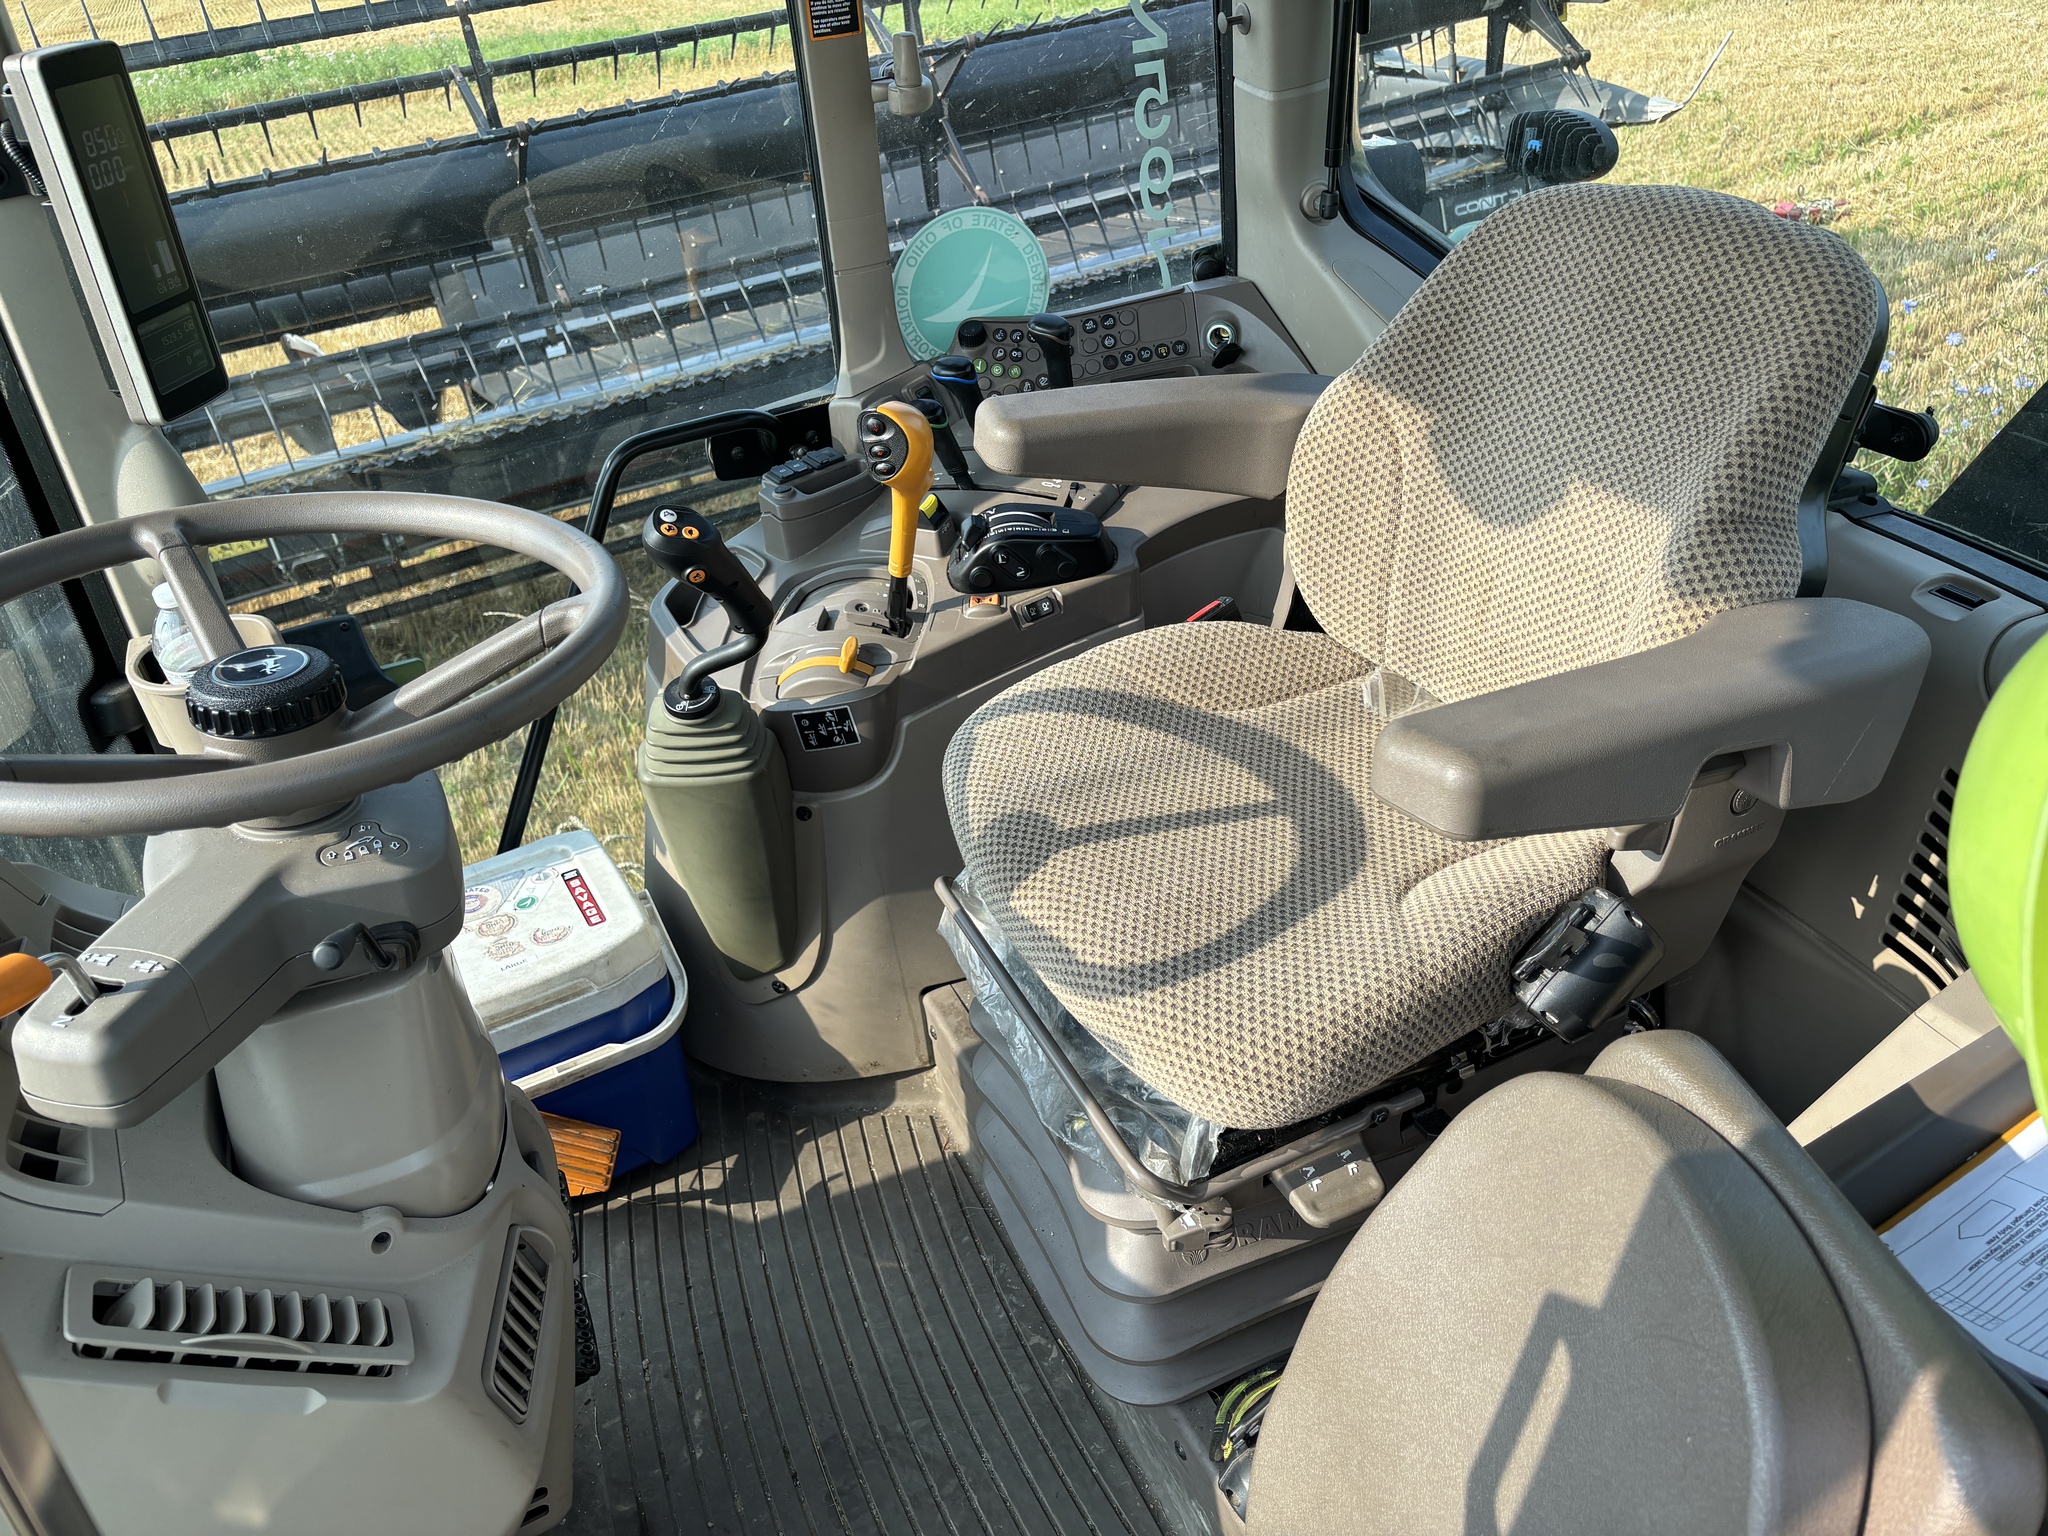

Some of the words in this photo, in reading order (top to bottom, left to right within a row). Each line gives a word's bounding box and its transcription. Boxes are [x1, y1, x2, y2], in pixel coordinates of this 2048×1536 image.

[88, 155, 127, 191] 0.00
[500, 958, 528, 971] LARGE
[51, 1015, 74, 1028] N
[2010, 1206, 2035, 1227] Damaged
[1998, 1223, 2013, 1237] Body
[2001, 1226, 2025, 1246] complete
[2024, 1226, 2043, 1242] Radio
[1981, 1242, 2003, 1261] diagram
[1967, 1257, 1983, 1273] below
